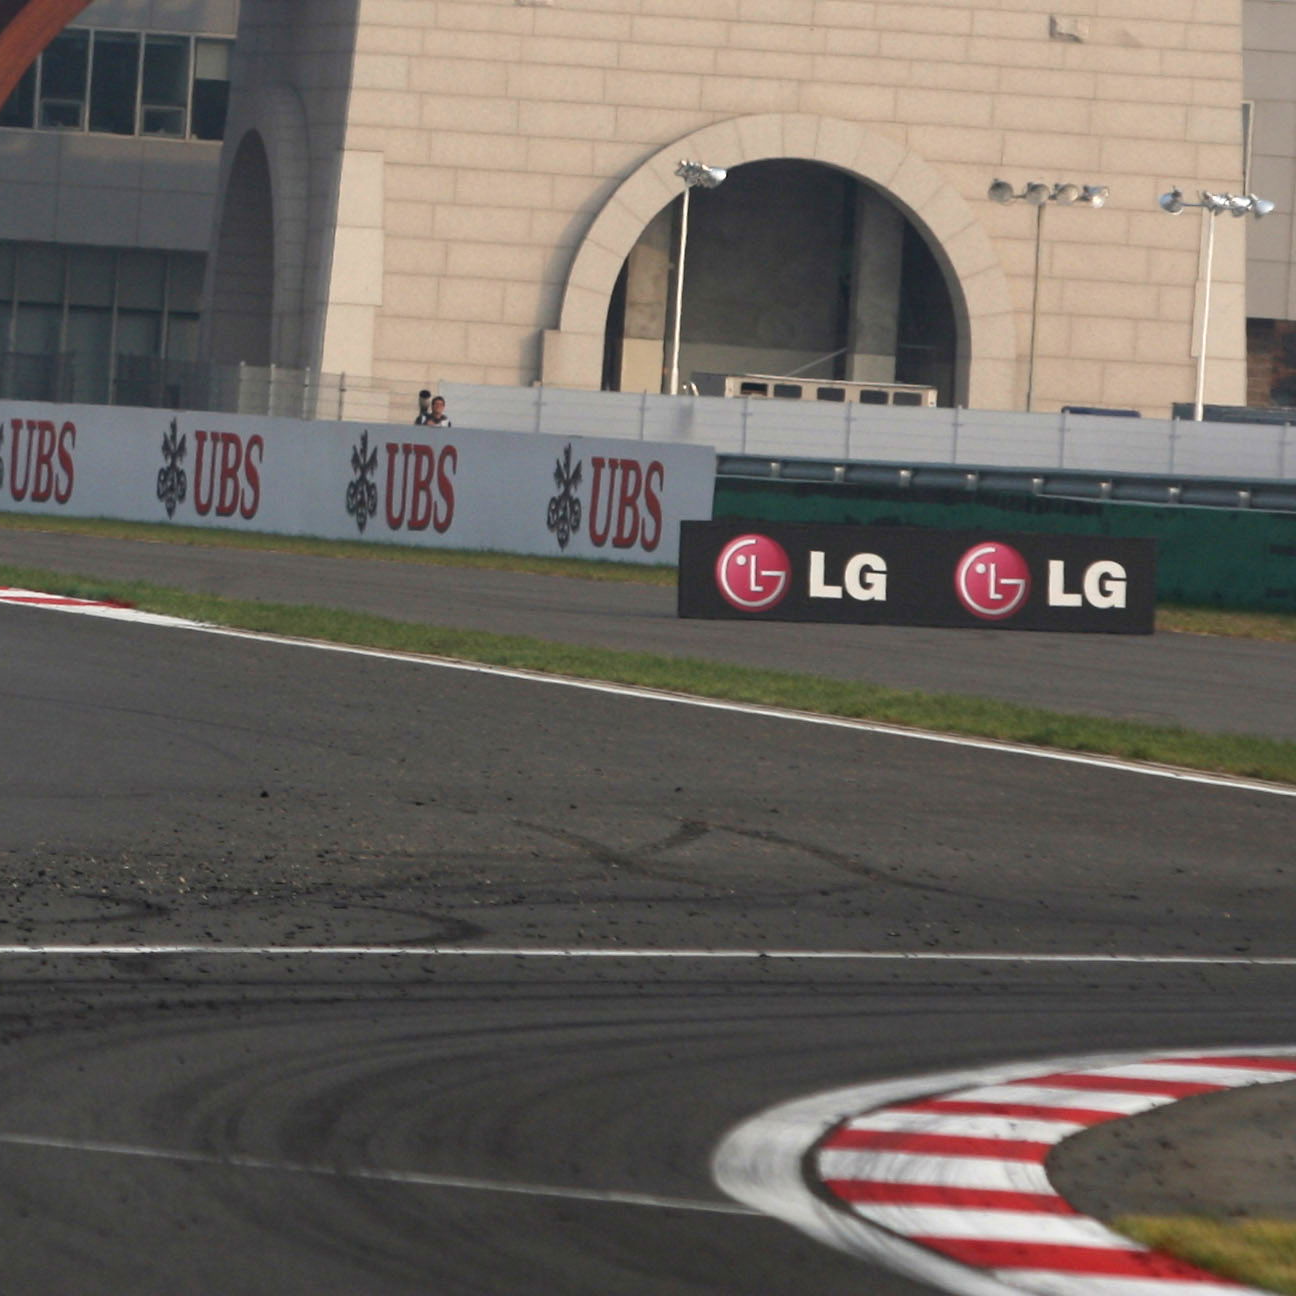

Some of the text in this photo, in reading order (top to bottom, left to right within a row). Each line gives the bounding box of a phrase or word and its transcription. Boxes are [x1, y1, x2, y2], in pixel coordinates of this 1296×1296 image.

[9, 418, 77, 504] UBS
[193, 430, 264, 520] UBS
[384, 442, 458, 534] UBS
[588, 457, 665, 553] UBS
[809, 551, 888, 602] LG
[1048, 559, 1128, 609] LG
